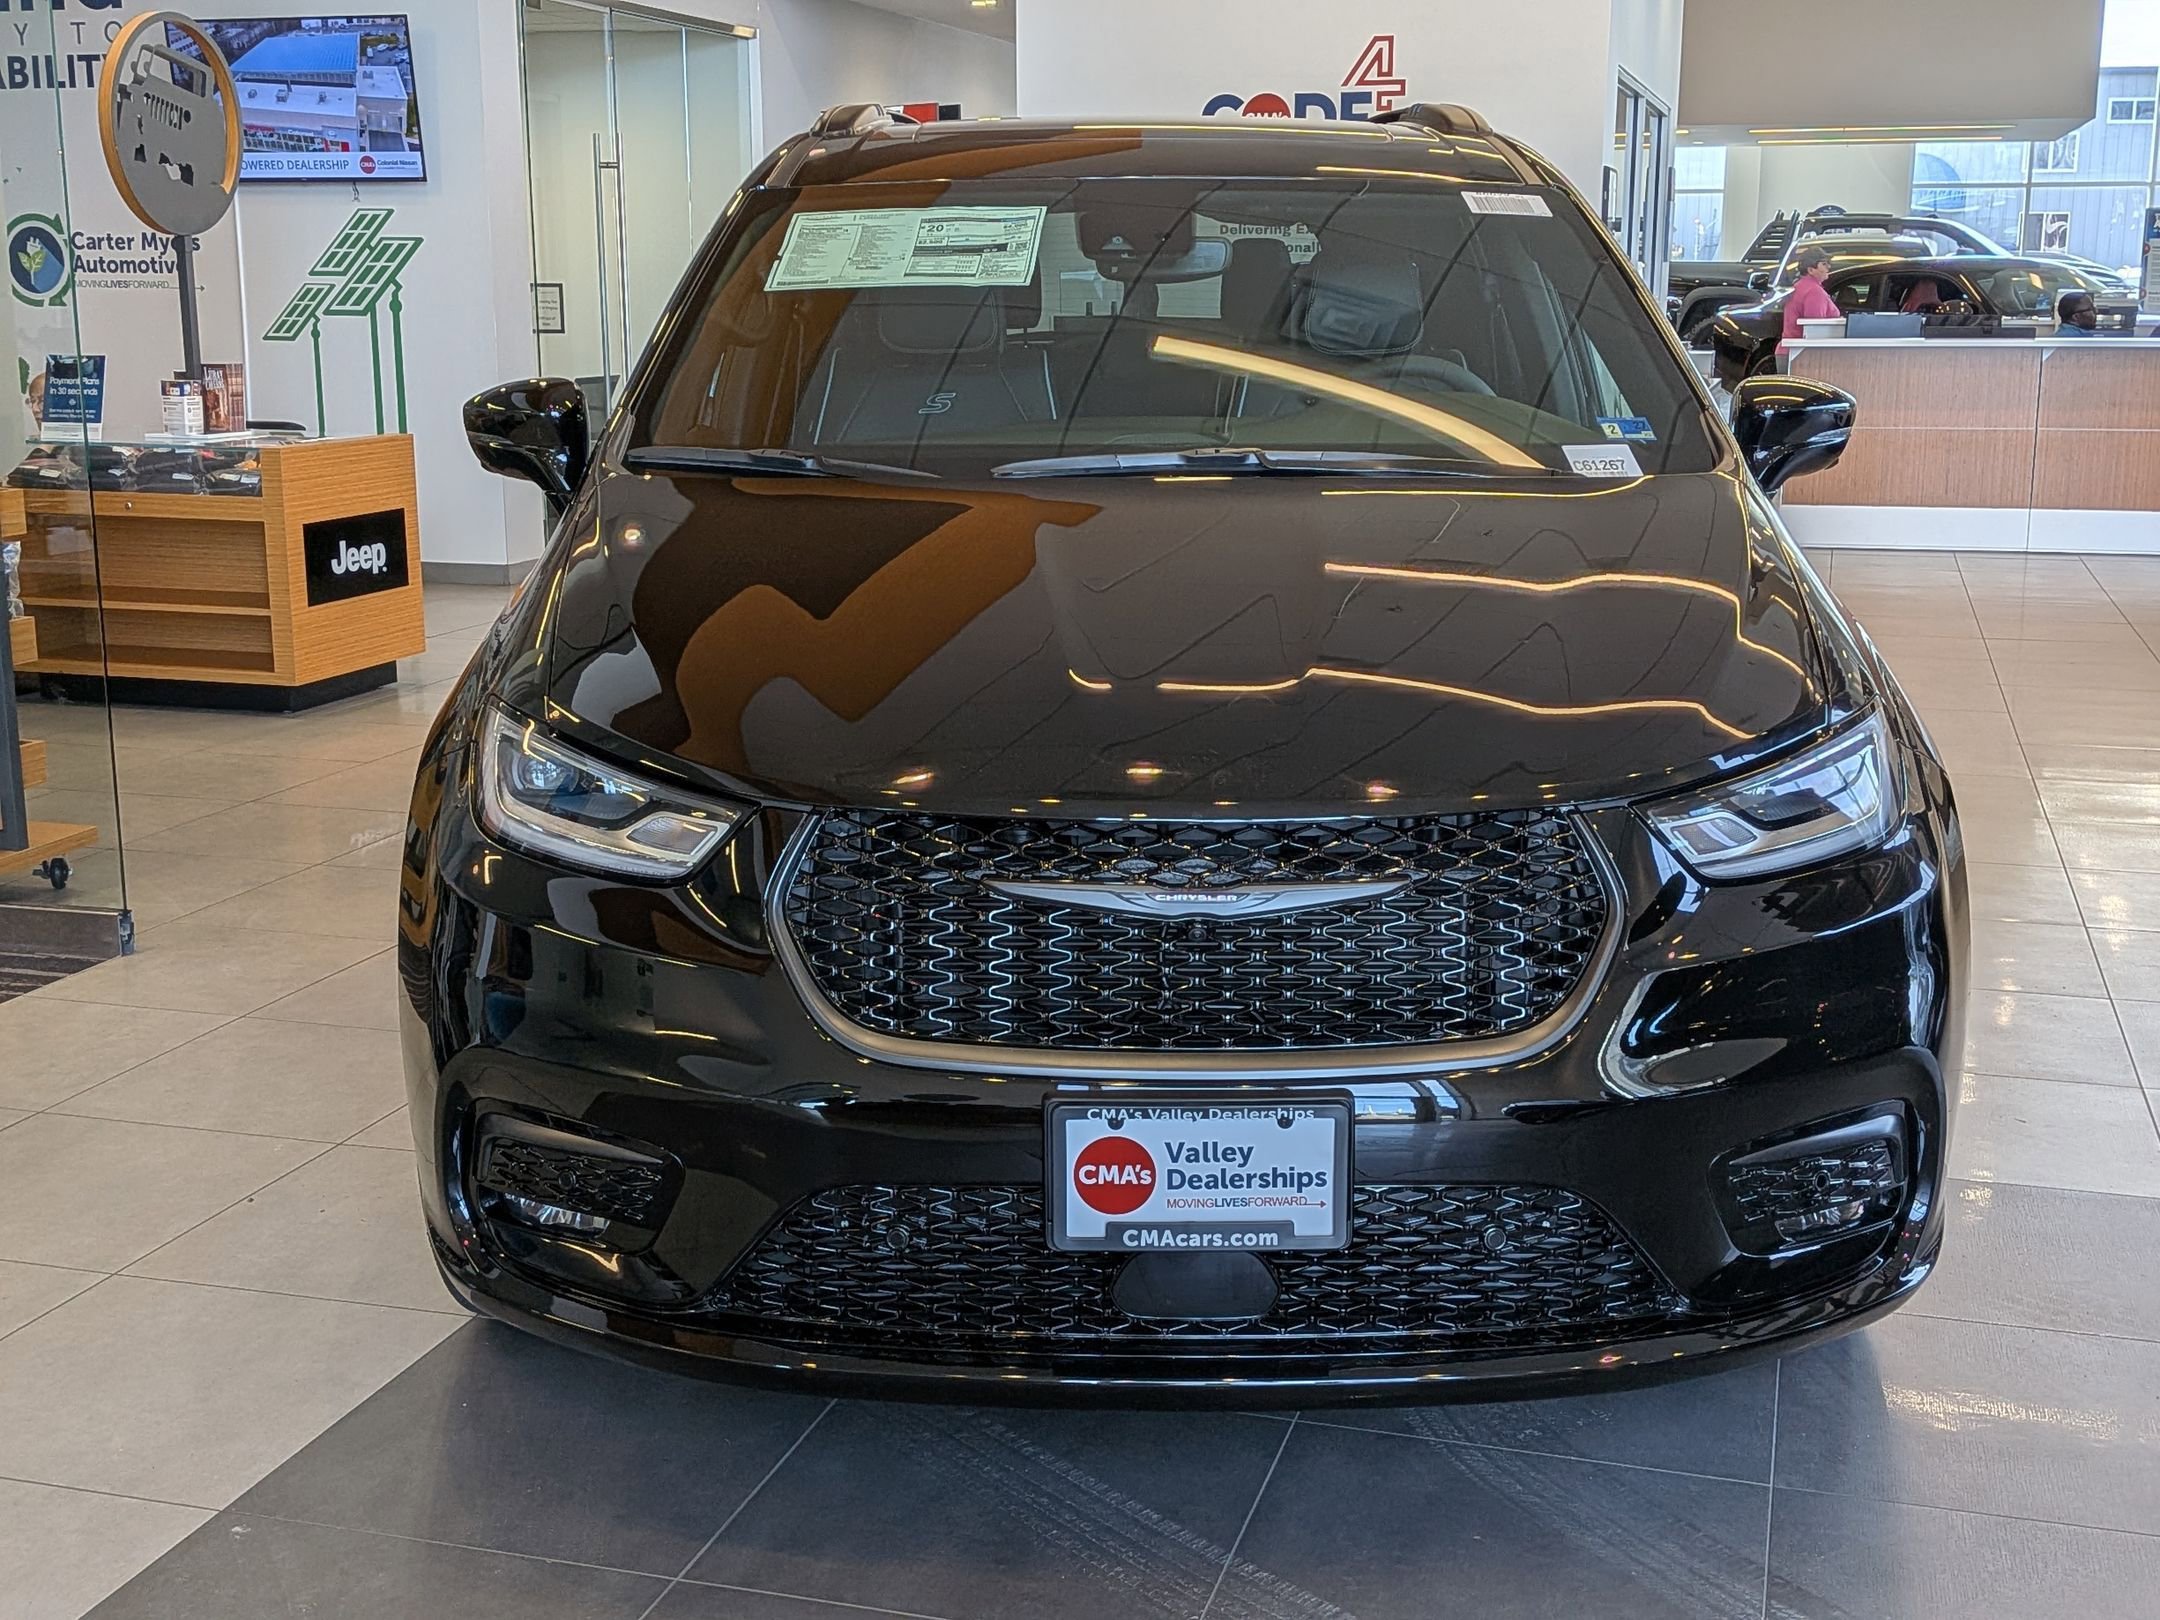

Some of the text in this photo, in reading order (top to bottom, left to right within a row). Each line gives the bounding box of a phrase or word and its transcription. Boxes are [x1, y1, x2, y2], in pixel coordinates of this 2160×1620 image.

[0, 54, 108, 90] BILIT
[240, 159, 350, 171] OWERED DEALERSHIP
[926, 224, 945, 233] 20
[1219, 223, 1309, 237] Delivering E
[70, 231, 201, 256] Carter Mys
[73, 253, 180, 274] Automotiv
[67, 387, 98, 396] secnds
[1607, 424, 1619, 435] 2
[1572, 459, 1625, 472] C61267
[1086, 1107, 1315, 1123] CMA's Valley Dealerships
[1164, 1141, 1255, 1169] Valley
[1078, 1165, 1152, 1186] CMA's
[1165, 1167, 1328, 1194] Dealerships
[1121, 1229, 1279, 1248] CMAcars.com
